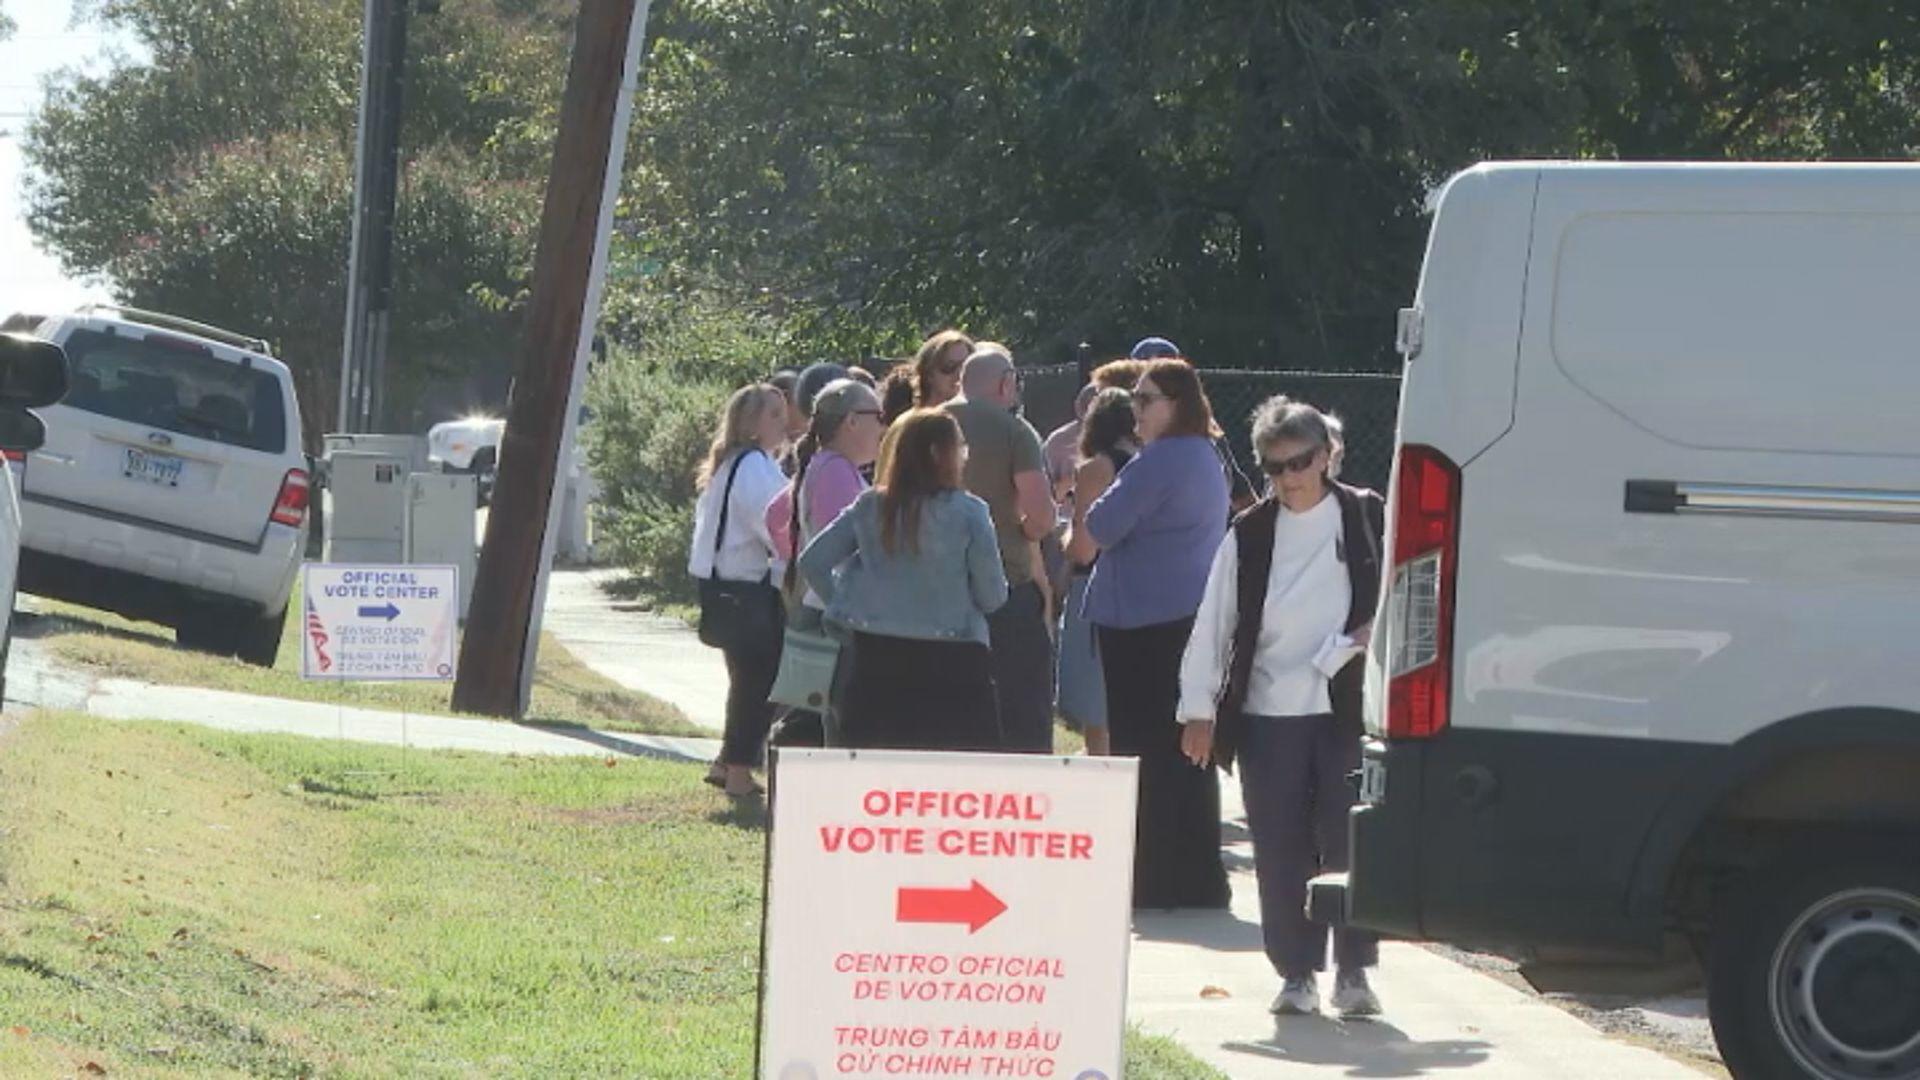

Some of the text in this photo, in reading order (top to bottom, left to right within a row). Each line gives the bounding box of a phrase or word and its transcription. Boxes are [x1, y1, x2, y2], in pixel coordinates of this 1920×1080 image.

[342, 571, 418, 585] OFFICIAL
[324, 584, 439, 599] VOTE CENTER
[863, 790, 1044, 821] OFFICIAL
[820, 826, 1094, 860] VOTE CENTER
[835, 953, 1065, 979] CENTRO OFICIAL
[854, 980, 890, 1000] DE
[835, 1027, 929, 1047] TRUNG
